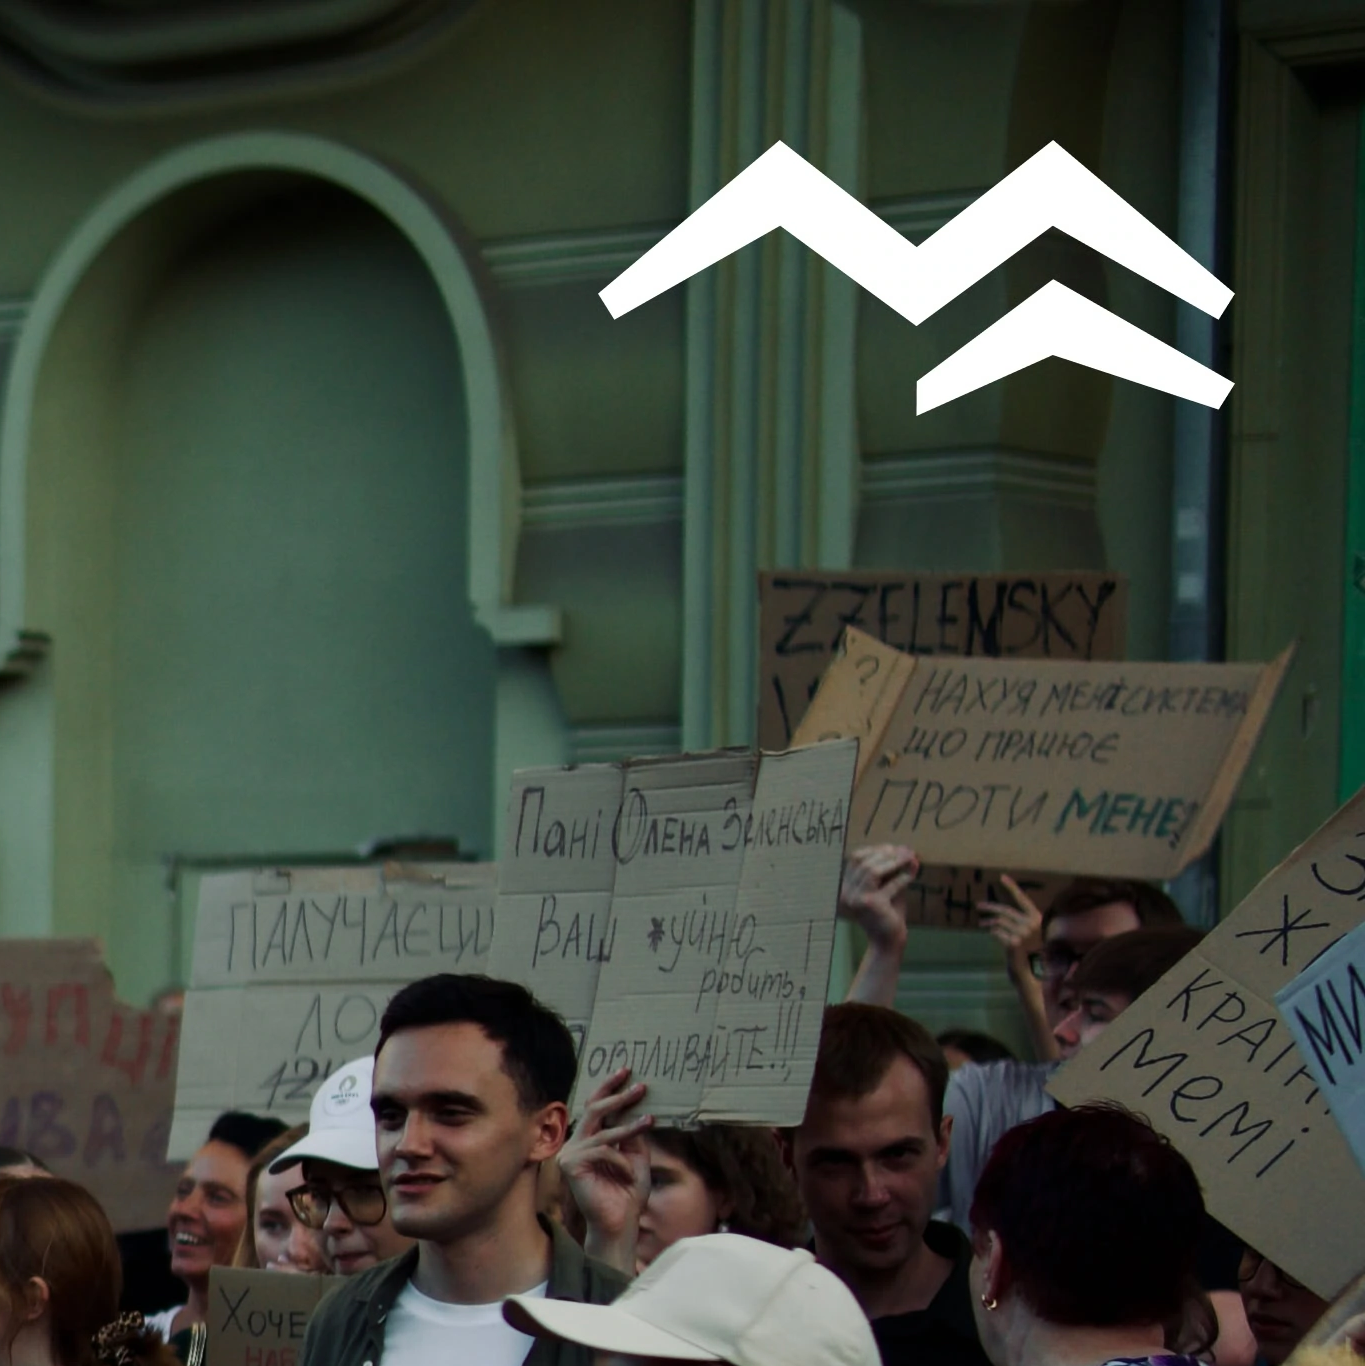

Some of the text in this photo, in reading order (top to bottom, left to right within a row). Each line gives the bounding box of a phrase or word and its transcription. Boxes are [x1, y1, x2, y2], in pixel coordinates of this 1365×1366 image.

[772, 579, 1117, 660] ZZELENSKY
[913, 668, 1038, 717] НАХУЯ
[903, 725, 1120, 764] ЩО ПРАЦЮЄ
[865, 777, 1050, 836] ПРОТИ
